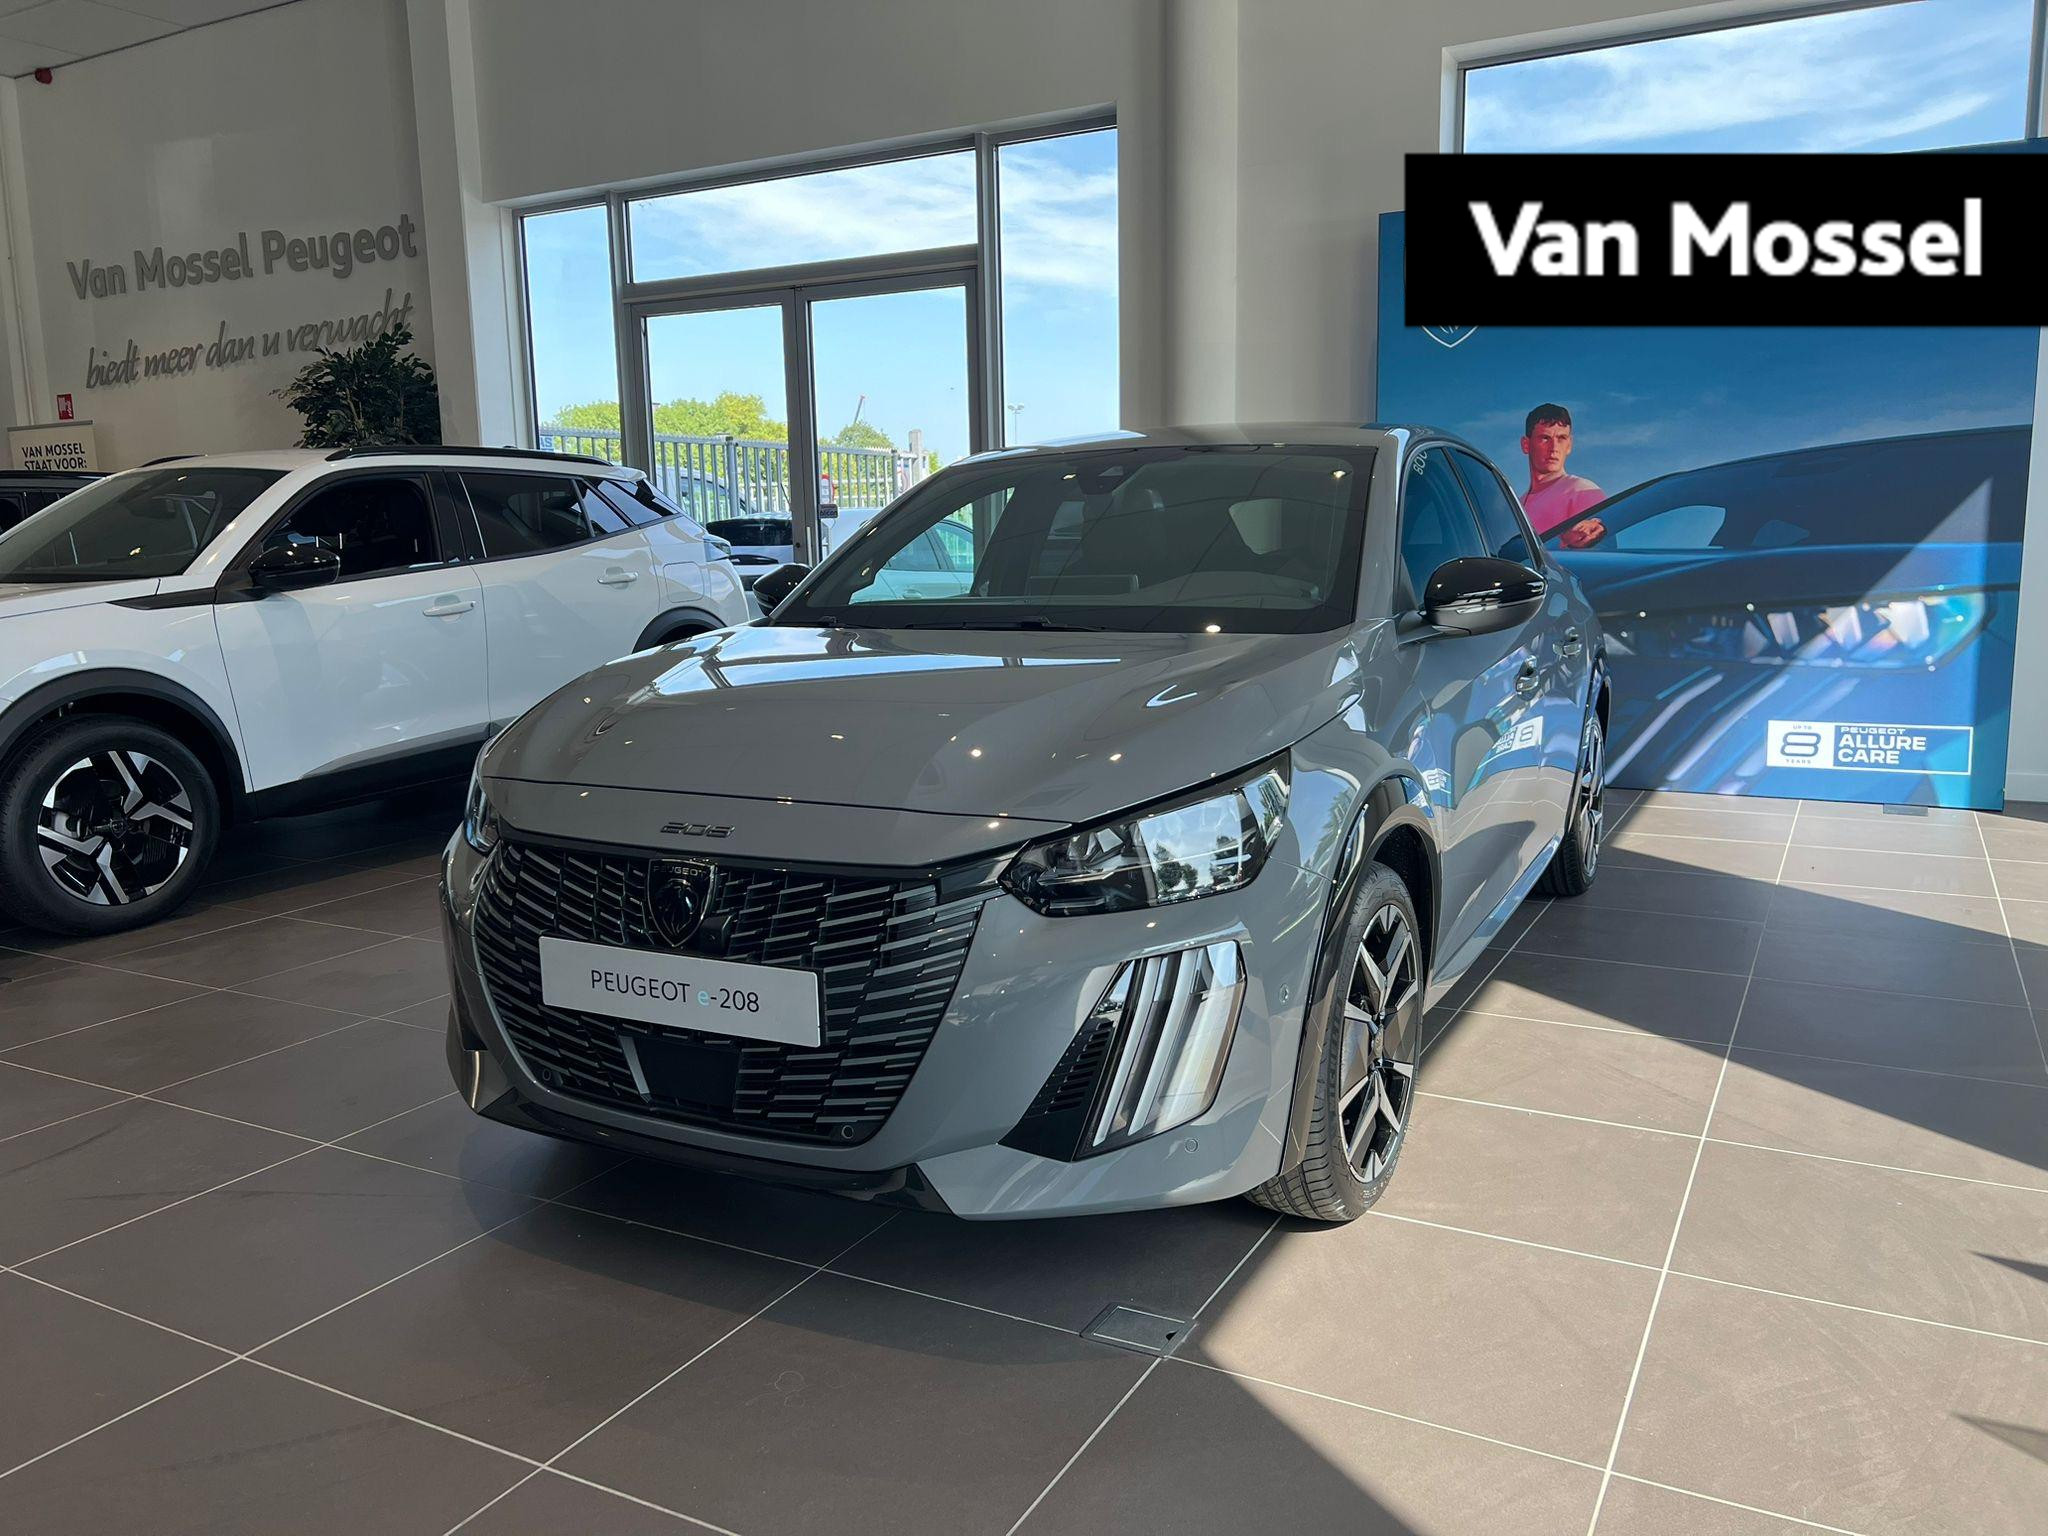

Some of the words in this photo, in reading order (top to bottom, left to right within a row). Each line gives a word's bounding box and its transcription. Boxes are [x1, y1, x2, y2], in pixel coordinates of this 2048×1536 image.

[66, 259, 126, 300] Van
[134, 231, 253, 291] Mossel
[261, 214, 417, 279] Peugeot
[86, 339, 140, 388] biedt
[144, 343, 203, 377] meer
[205, 320, 254, 367] dan
[262, 331, 279, 357] u
[287, 287, 413, 351] verwacht
[22, 446, 43, 459] VAN
[45, 442, 85, 457] MOSSEL
[24, 459, 53, 470] STAAT
[54, 457, 88, 471] VOOR:
[1840, 727, 1906, 735] PEUGEOT
[1780, 732, 1821, 757] 8
[1838, 733, 1927, 751] ALLURE
[1838, 748, 1900, 765] CARE
[660, 822, 736, 838] 208
[591, 970, 691, 1002] PEUGEOT
[697, 988, 760, 1012] e-208
